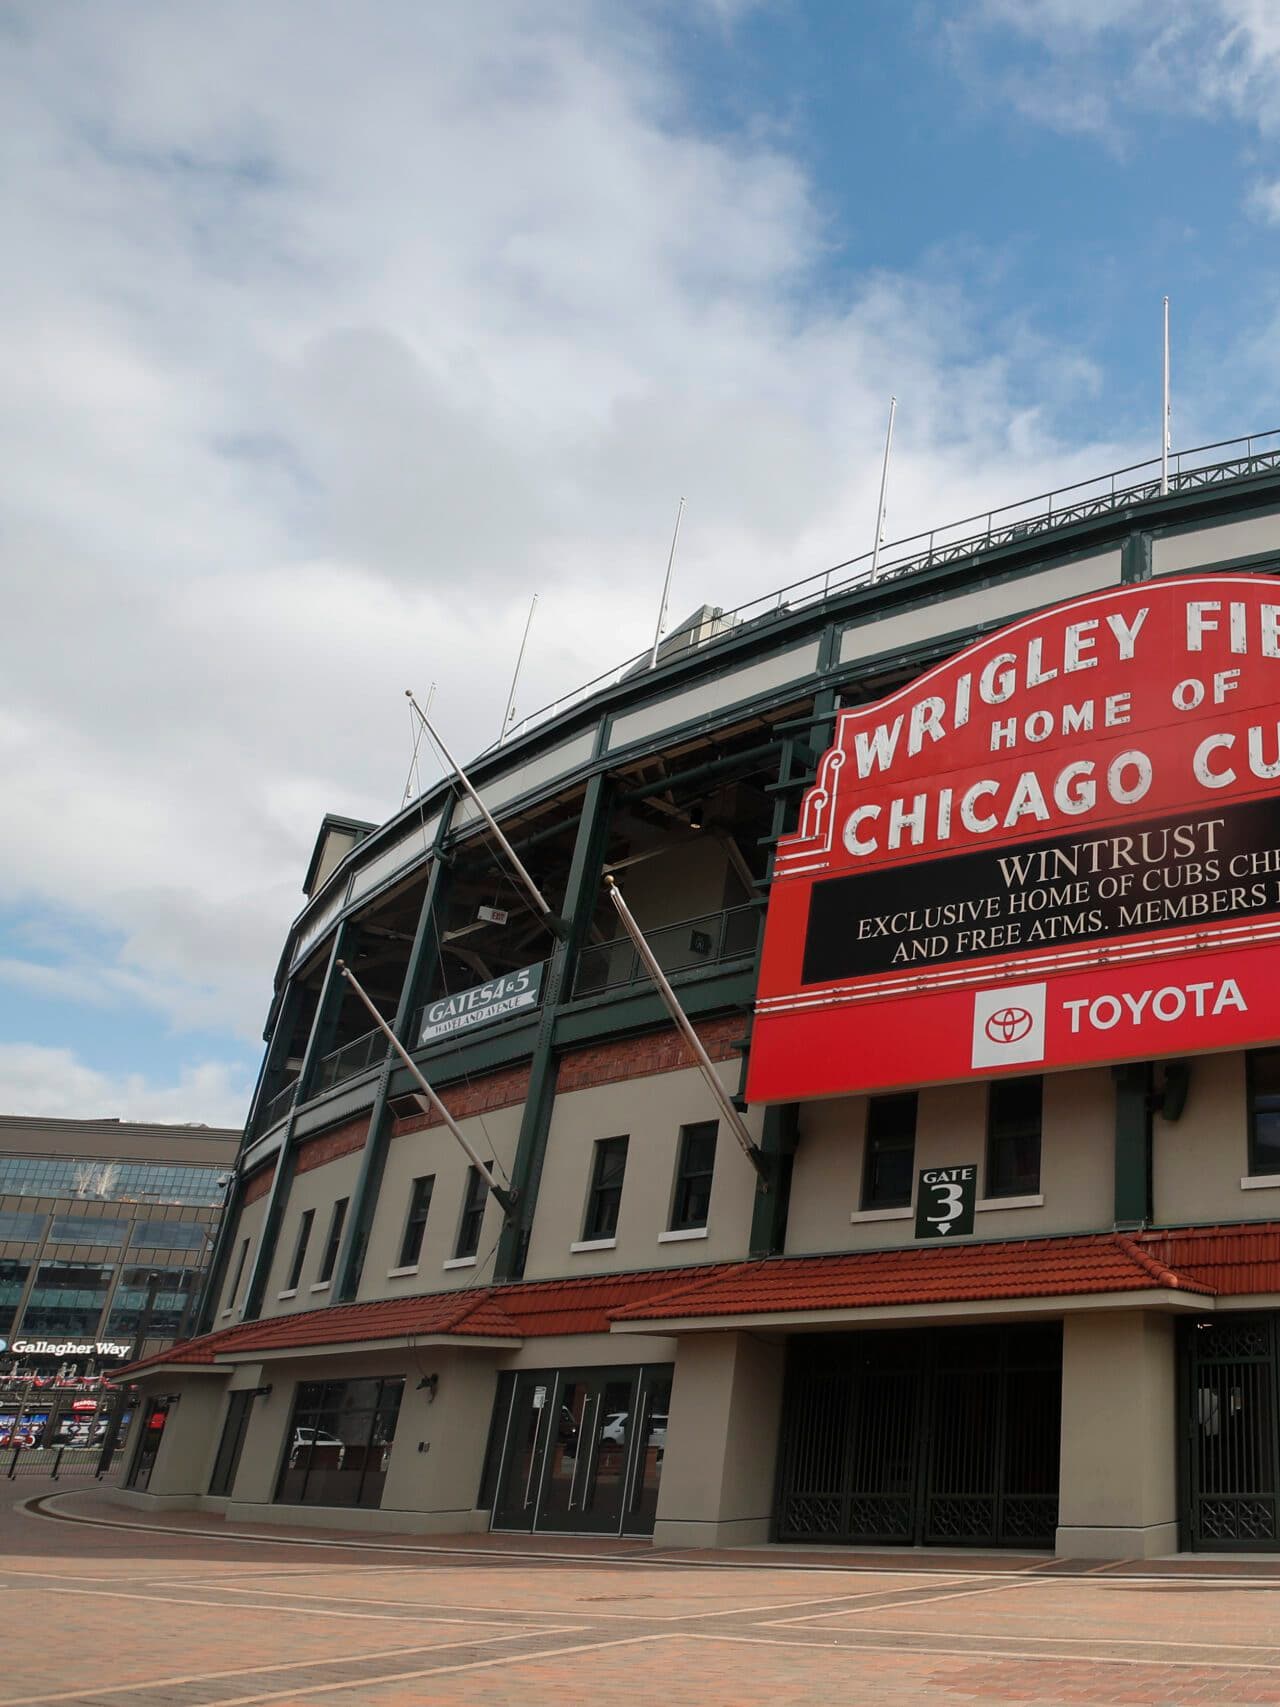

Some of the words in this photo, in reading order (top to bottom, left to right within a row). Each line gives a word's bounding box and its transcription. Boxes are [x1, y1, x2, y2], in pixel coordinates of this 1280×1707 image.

[854, 607, 1150, 779] WRIGLEY
[990, 693, 1132, 751] HOME
[1172, 668, 1240, 711] OF
[842, 750, 1153, 856] CHICAGO
[997, 818, 1225, 888] WINTRUST
[856, 896, 1001, 940] EXCLUSIVE
[1008, 881, 1090, 915] HOME
[1098, 874, 1134, 899] OF
[1142, 860, 1220, 892] CUBS
[890, 935, 949, 963] AND
[955, 923, 1022, 953] FREE
[1026, 910, 1109, 942] ATMS.
[1117, 883, 1267, 928] MEMBERS
[428, 984, 494, 1022] GATES
[486, 997, 520, 1019] AVENUE
[1063, 978, 1248, 1033] TOYOTA
[923, 1168, 973, 1184] GATE
[926, 1183, 963, 1222] 3
[12, 1340, 95, 1356] Gallagher
[96, 1342, 131, 1357] Way
